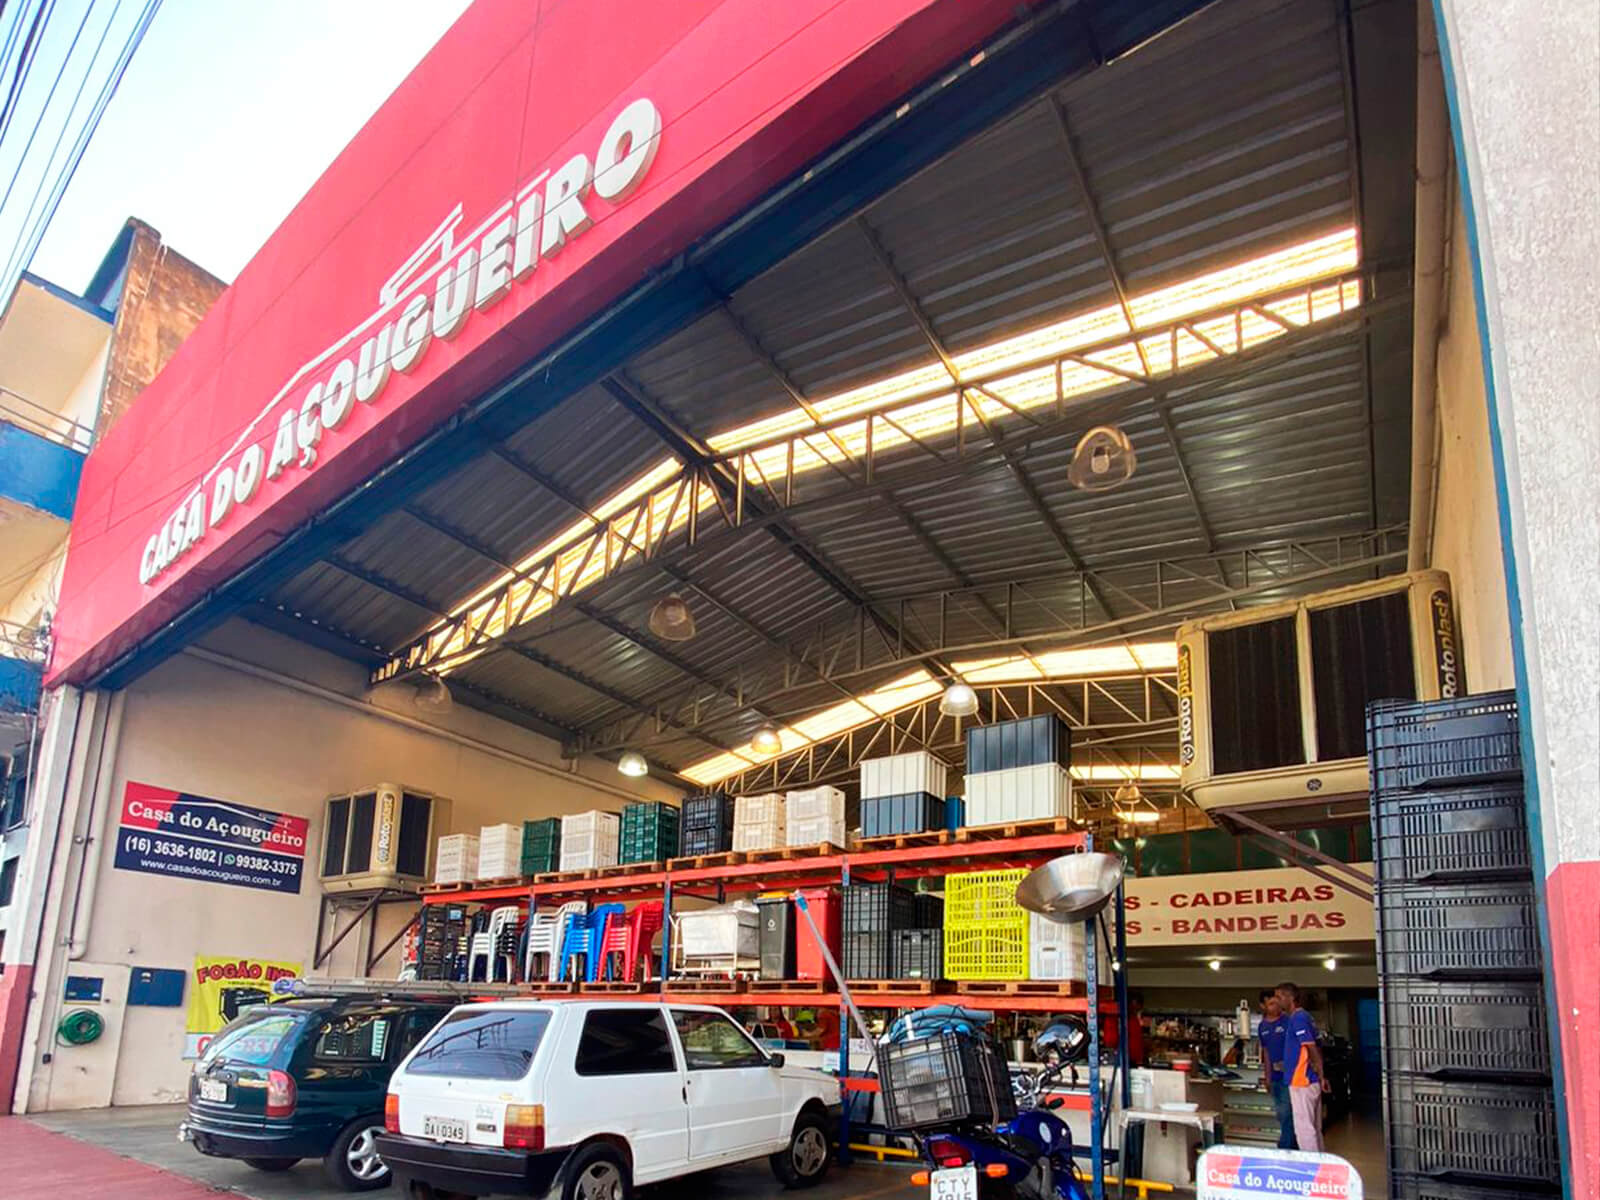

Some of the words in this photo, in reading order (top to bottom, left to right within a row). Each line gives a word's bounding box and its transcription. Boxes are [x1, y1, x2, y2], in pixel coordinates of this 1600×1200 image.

[139, 491, 206, 584] CASA
[210, 443, 264, 529] DO
[266, 98, 662, 481] AÇOUGUEIRO
[1434, 594, 1457, 698] Rotoplast
[127, 801, 175, 824] Casa
[179, 811, 202, 829] do
[205, 816, 303, 847] Açougueiro
[124, 835, 151, 856] (16)
[153, 841, 216, 863] 3636-1802
[236, 854, 298, 875] 99382-3375
[140, 858, 282, 887] www.casadoacougueiro.com.br
[1169, 885, 1335, 909] CADEIRAS
[1171, 912, 1347, 934] BANDEJAS
[196, 960, 262, 985] FOGÃO
[937, 1175, 971, 1194] CTY
[1208, 1168, 1241, 1185] Casa
[1244, 1172, 1262, 1187] do
[1265, 1174, 1350, 1196] Açougueiro
